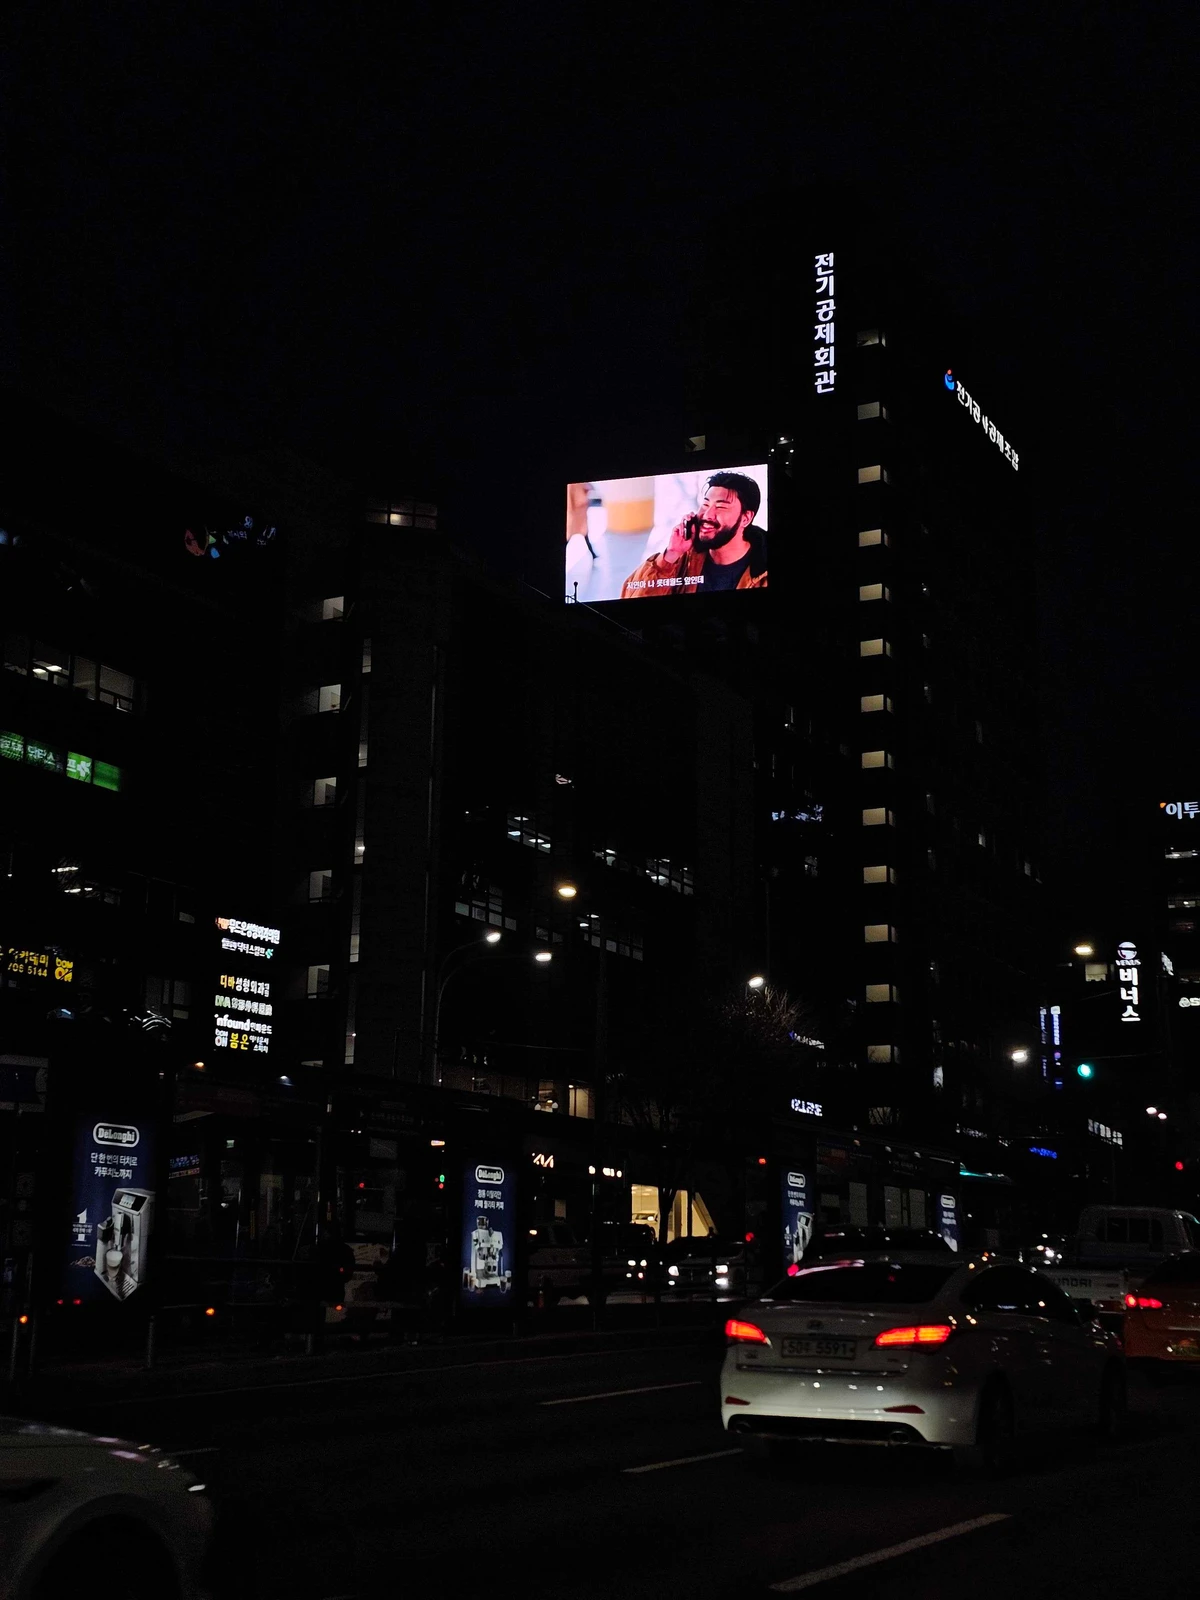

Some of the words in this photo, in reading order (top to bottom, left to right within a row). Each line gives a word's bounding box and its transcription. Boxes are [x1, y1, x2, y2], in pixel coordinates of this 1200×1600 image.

[814, 252, 837, 393] 전기공제회관
[657, 578, 682, 587] 롯데월드
[1119, 967, 1141, 1022] 비너스
[94, 1166, 132, 1180] 카푸치노까지
[816, 1340, 847, 1356] 5591
